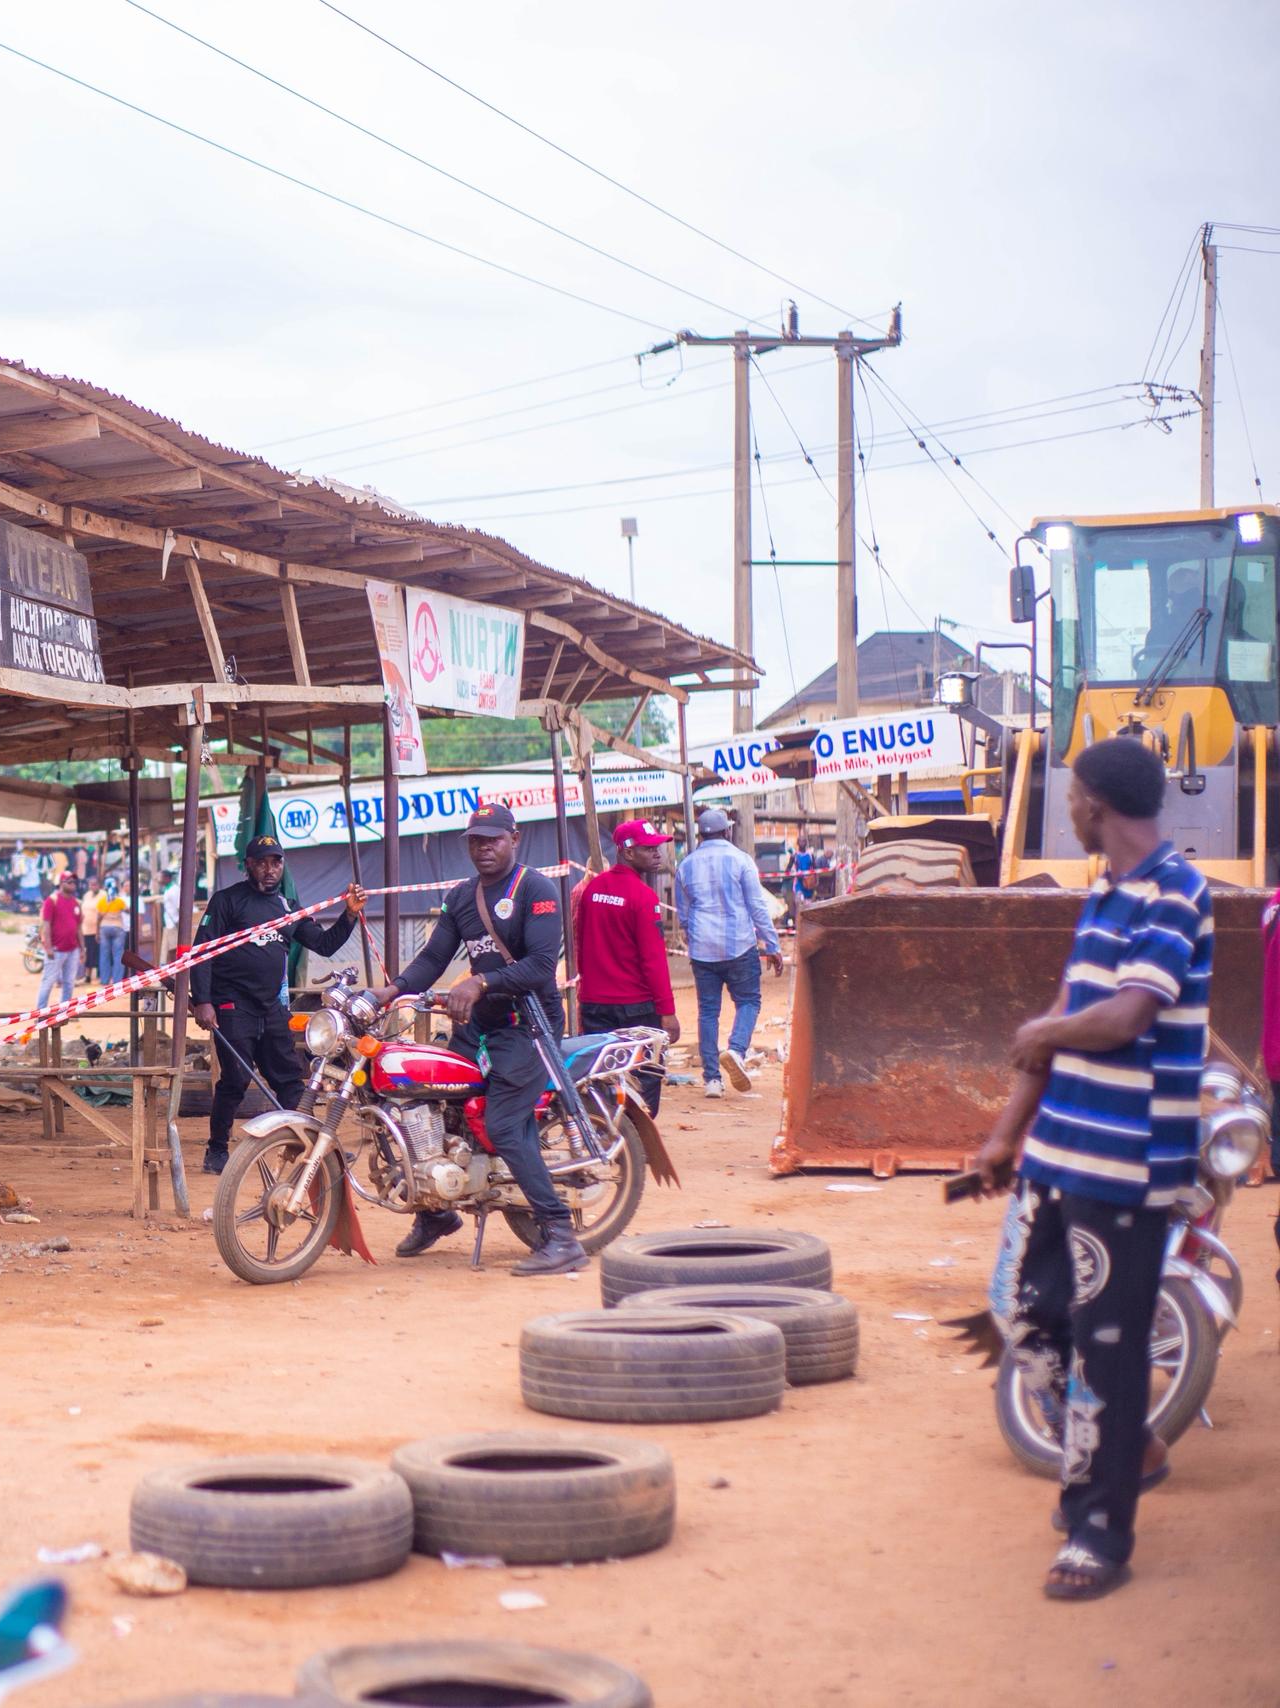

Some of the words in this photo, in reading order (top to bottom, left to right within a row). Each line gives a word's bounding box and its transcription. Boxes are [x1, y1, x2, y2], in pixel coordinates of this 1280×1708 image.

[10, 597, 39, 637] AUCHI
[13, 632, 43, 670] AUCHI
[449, 609, 518, 676] NURTW
[842, 720, 934, 754] ENUGU
[844, 757, 873, 770] Mile,
[877, 748, 932, 765] Holygost
[594, 775, 625, 784] KPOMA
[638, 773, 665, 782] BENIN
[752, 771, 768, 784] Oji
[480, 788, 556, 808] MOTORS
[602, 786, 630, 795] AUCHI
[632, 795, 667, 804] ONISHA
[329, 787, 480, 829] ABIODUN
[531, 901, 557, 915] ESSC
[592, 893, 625, 907] OFFICER
